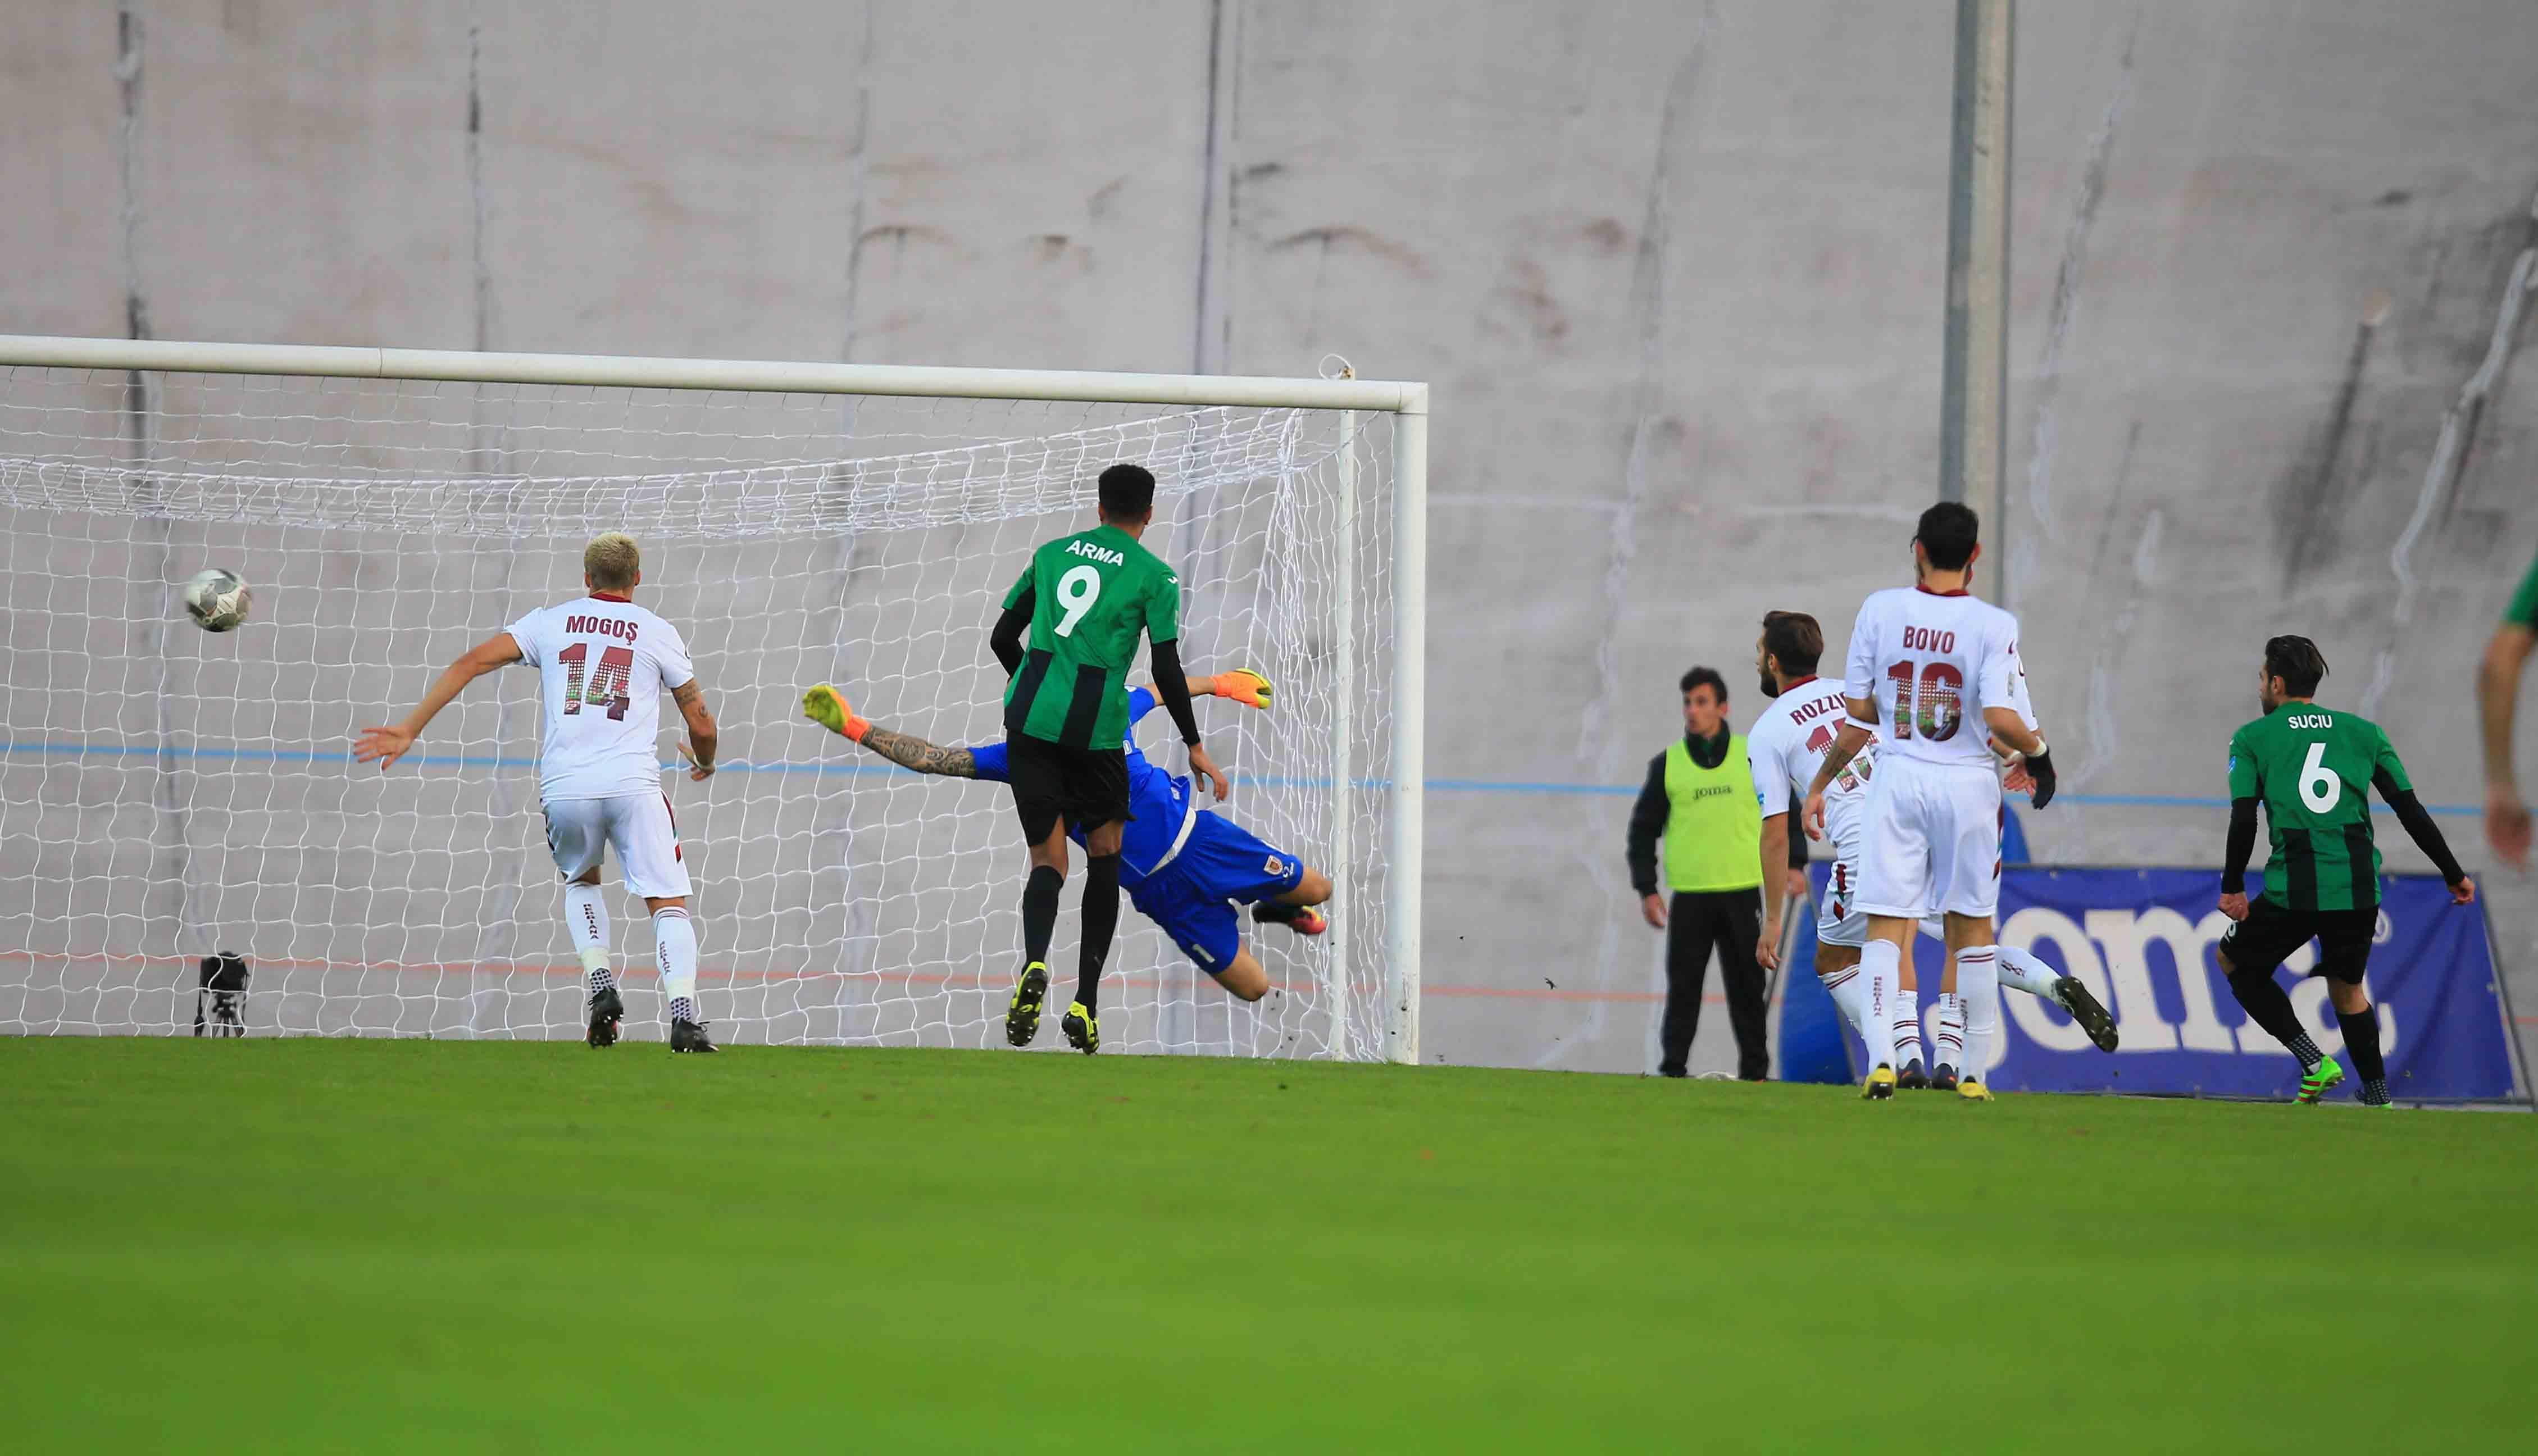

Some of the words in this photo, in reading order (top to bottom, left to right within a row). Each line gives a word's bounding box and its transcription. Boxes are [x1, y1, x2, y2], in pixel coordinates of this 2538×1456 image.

[1065, 540, 1124, 566] ARMA
[1054, 565, 1101, 638] 9
[565, 615, 639, 645] MOGOŞ
[1902, 626, 1955, 654] BOVO
[558, 643, 634, 722] 14
[1887, 659, 1963, 741] 16
[1790, 691, 1846, 726] ROZZI
[2287, 714, 2333, 730] SUCIU
[2298, 743, 2341, 814] 6
